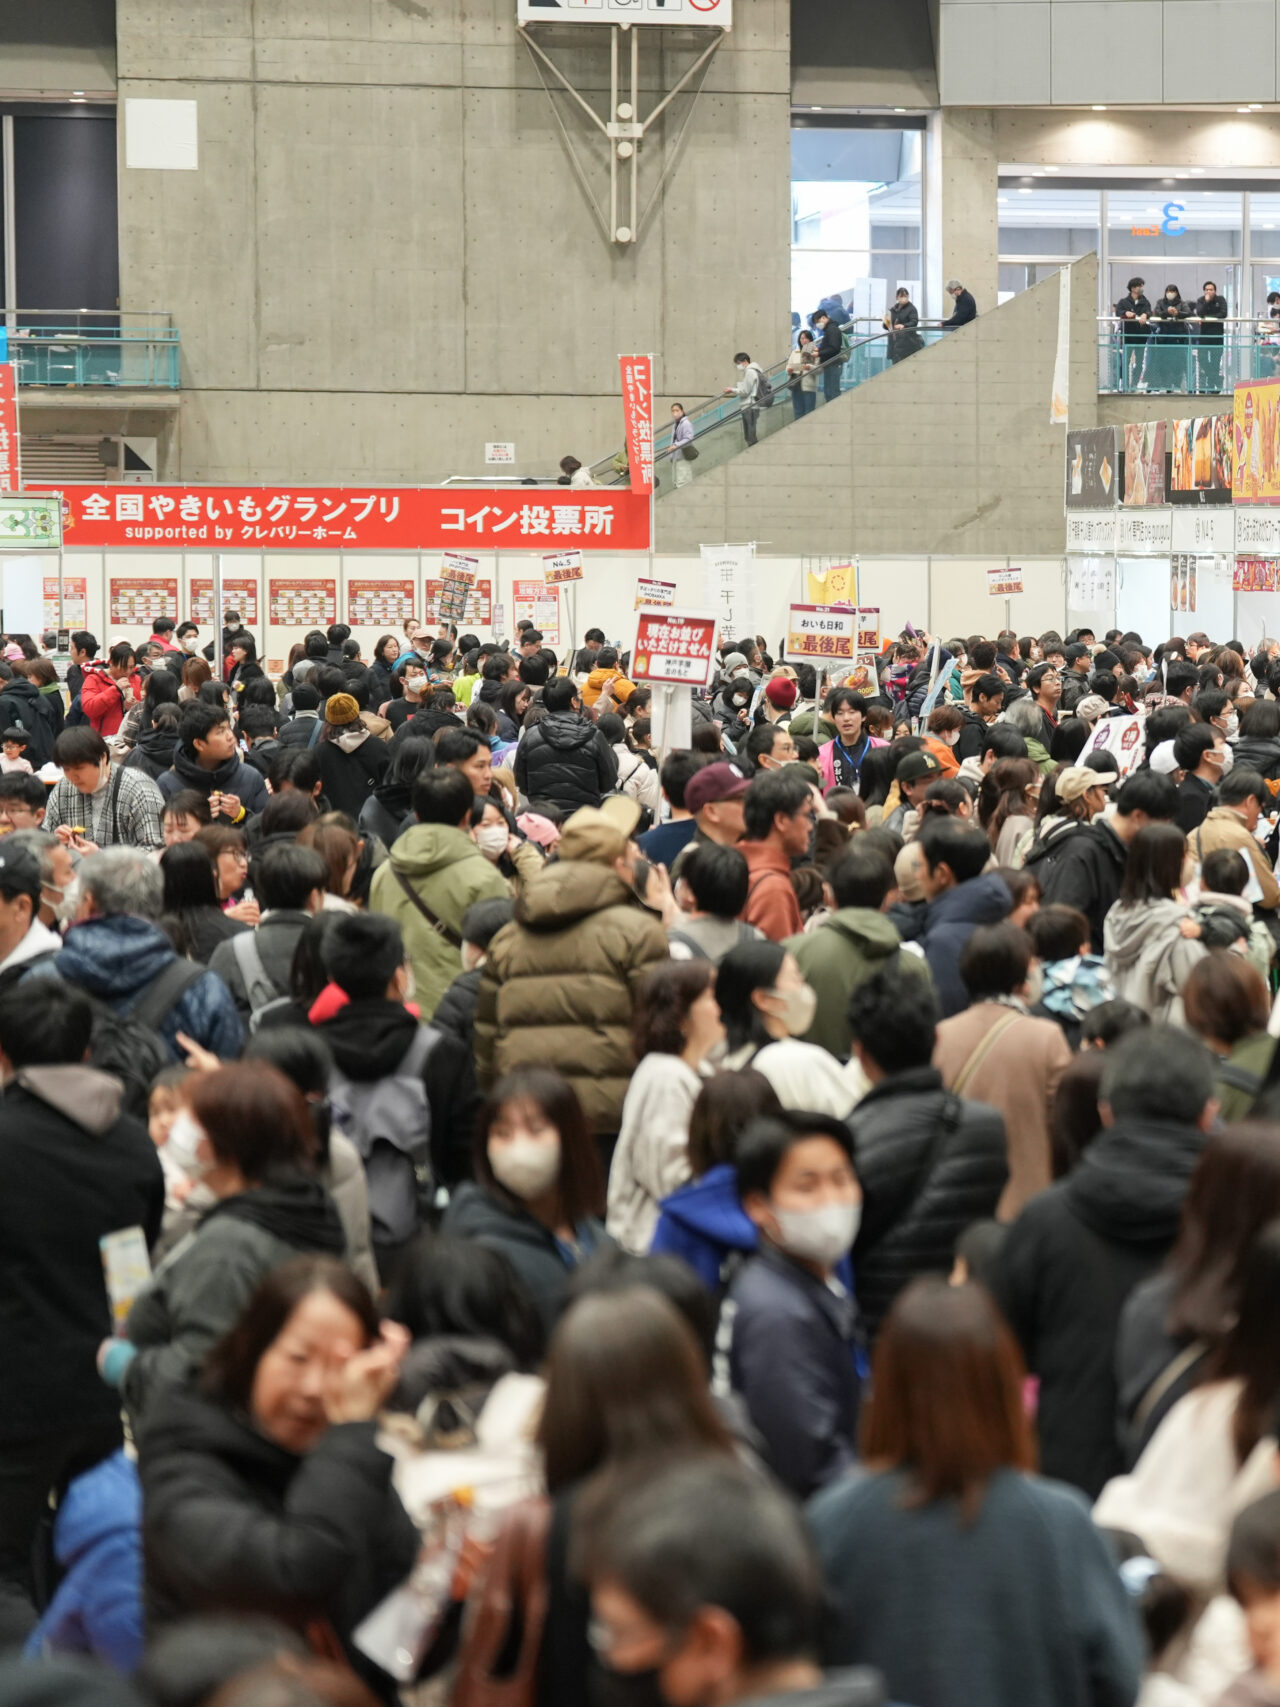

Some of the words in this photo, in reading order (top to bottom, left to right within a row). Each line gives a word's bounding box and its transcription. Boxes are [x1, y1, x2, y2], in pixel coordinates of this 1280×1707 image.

[633, 365, 653, 484] コイン投票所
[81, 493, 400, 523] 全国やきいもグランプリ
[440, 505, 615, 535] コイン投票所
[125, 525, 207, 540] supported
[215, 525, 233, 540] by
[240, 525, 358, 540] クレバリーホーム
[448, 568, 475, 585] 最後尾
[553, 566, 581, 580] 最後尾
[646, 623, 705, 641] 現在お並び
[801, 619, 844, 631] おいも日和
[637, 638, 710, 656] いただけません
[803, 635, 851, 655] 最後尾
